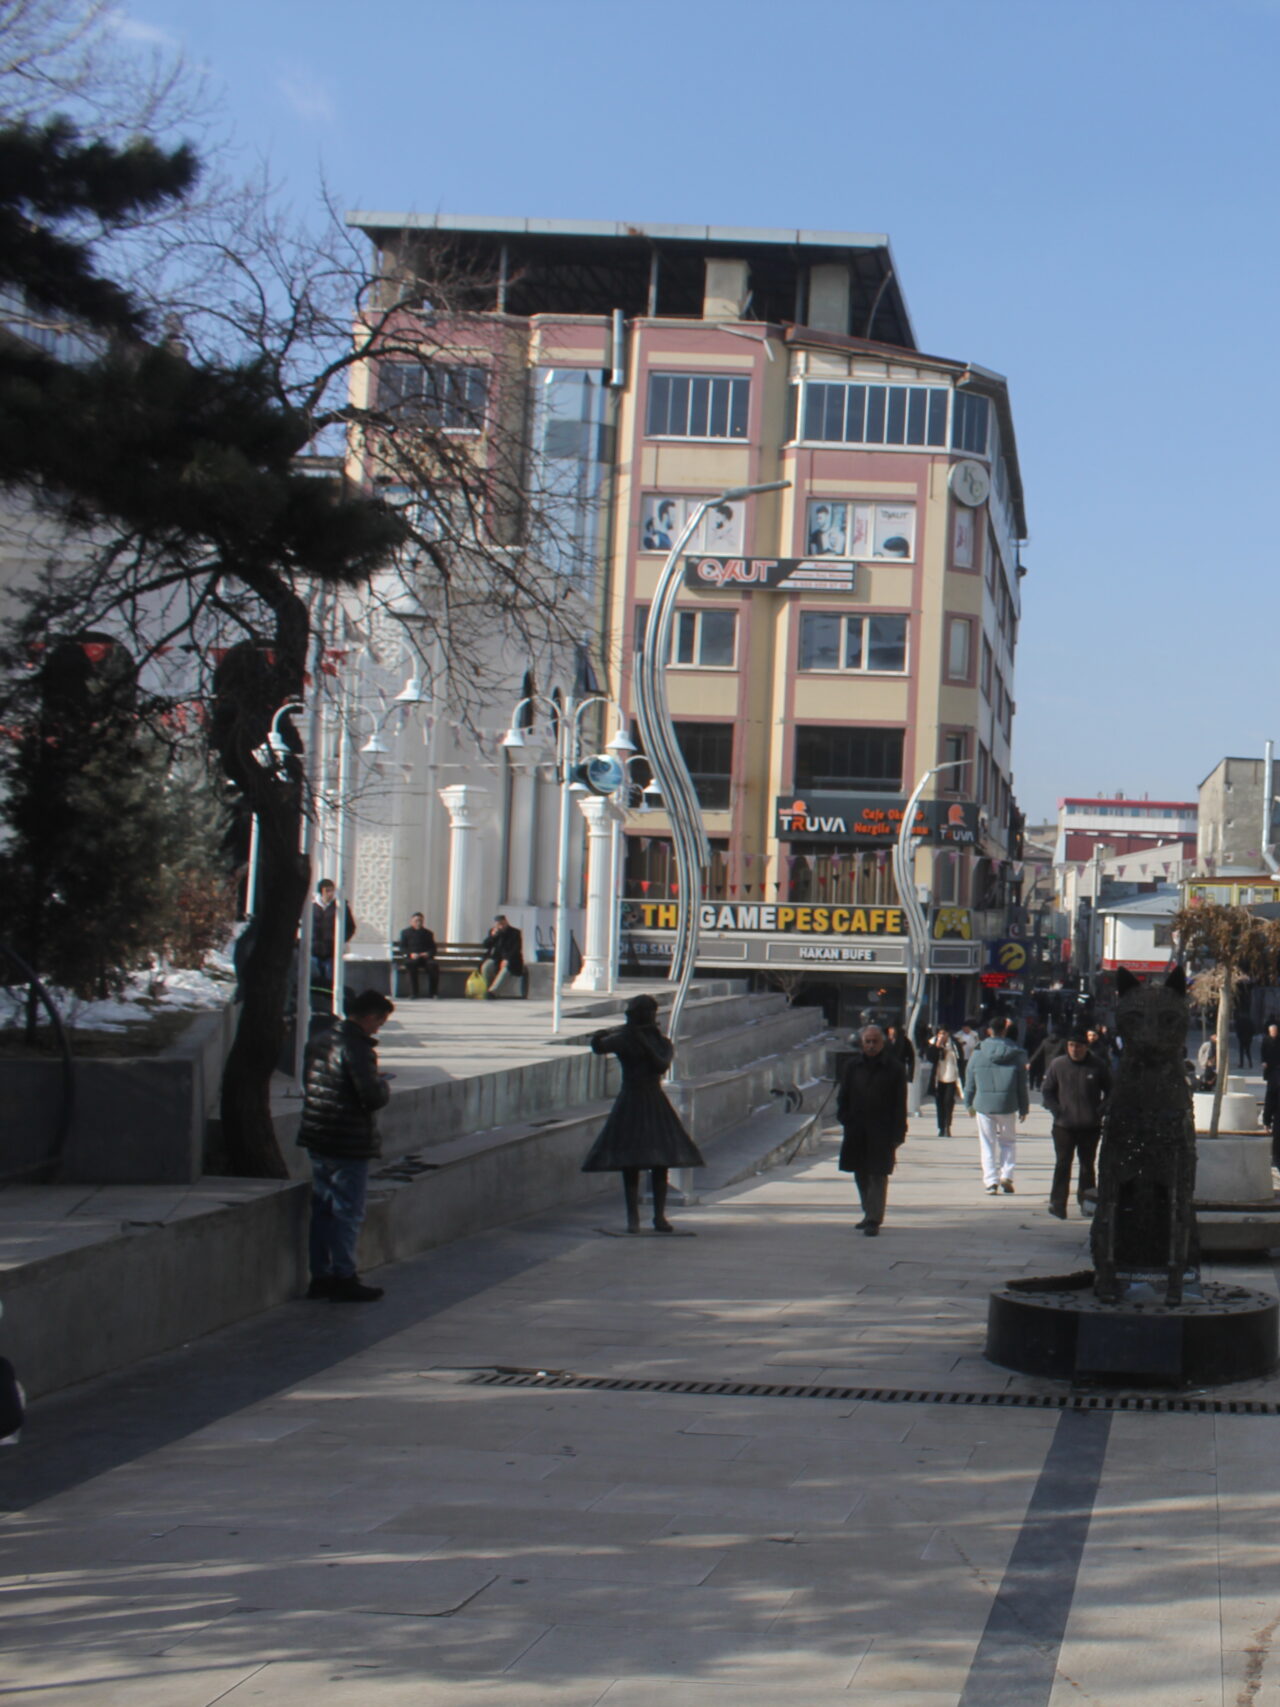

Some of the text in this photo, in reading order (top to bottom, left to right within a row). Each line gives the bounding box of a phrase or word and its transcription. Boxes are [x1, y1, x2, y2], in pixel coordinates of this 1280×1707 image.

[779, 815, 846, 832] TRUVA
[940, 829, 975, 842] TRUVA
[799, 946, 839, 960] HAKAN
